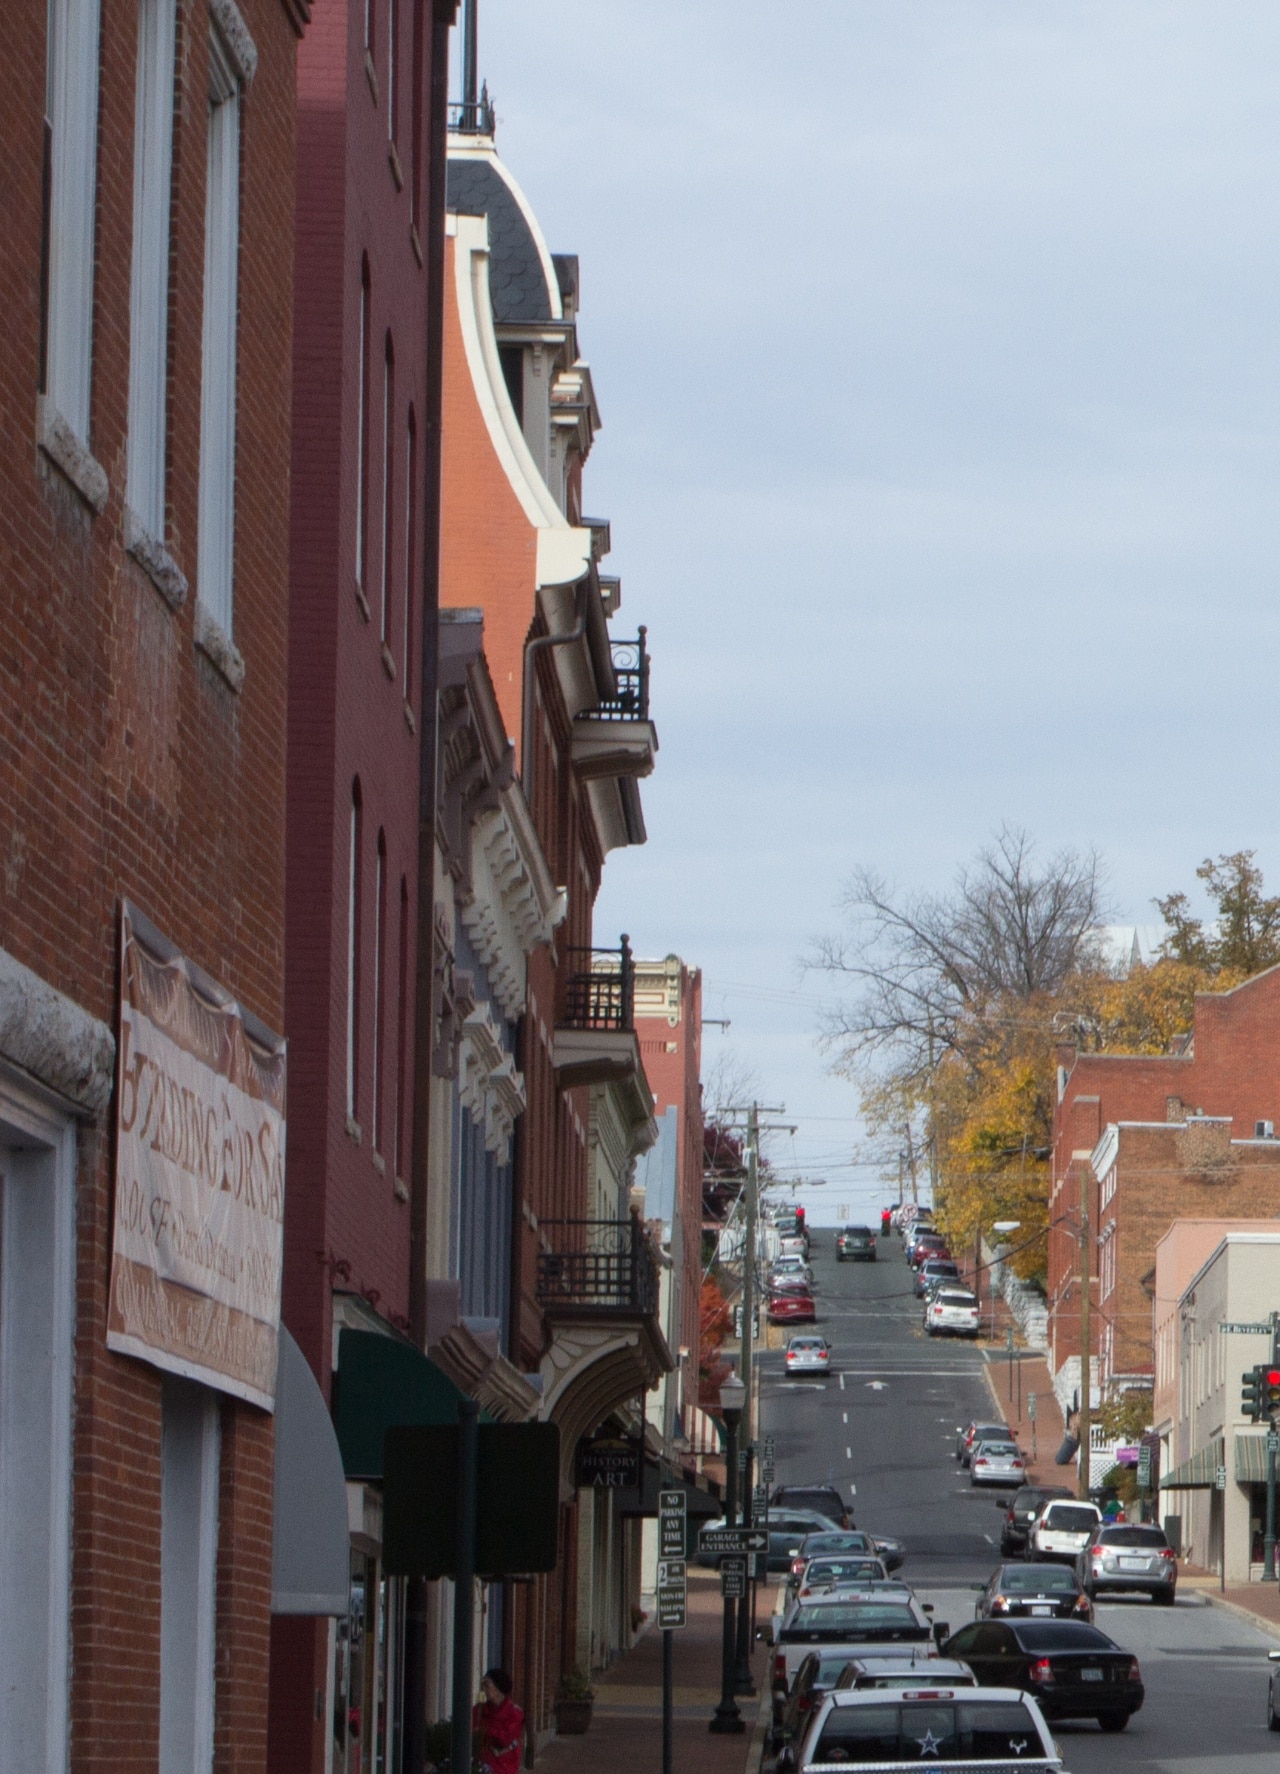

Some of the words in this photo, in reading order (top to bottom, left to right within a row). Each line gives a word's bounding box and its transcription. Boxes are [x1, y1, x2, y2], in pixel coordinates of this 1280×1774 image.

[583, 1456, 637, 1467] HISTORY
[593, 1472, 627, 1486] ART
[667, 1496, 678, 1505] NO
[666, 1520, 679, 1530] ANY
[664, 1532, 682, 1541] TIME
[706, 1534, 742, 1542] GARAGE
[701, 1542, 748, 1551] ENTRANCE
[659, 1565, 667, 1583] 2
